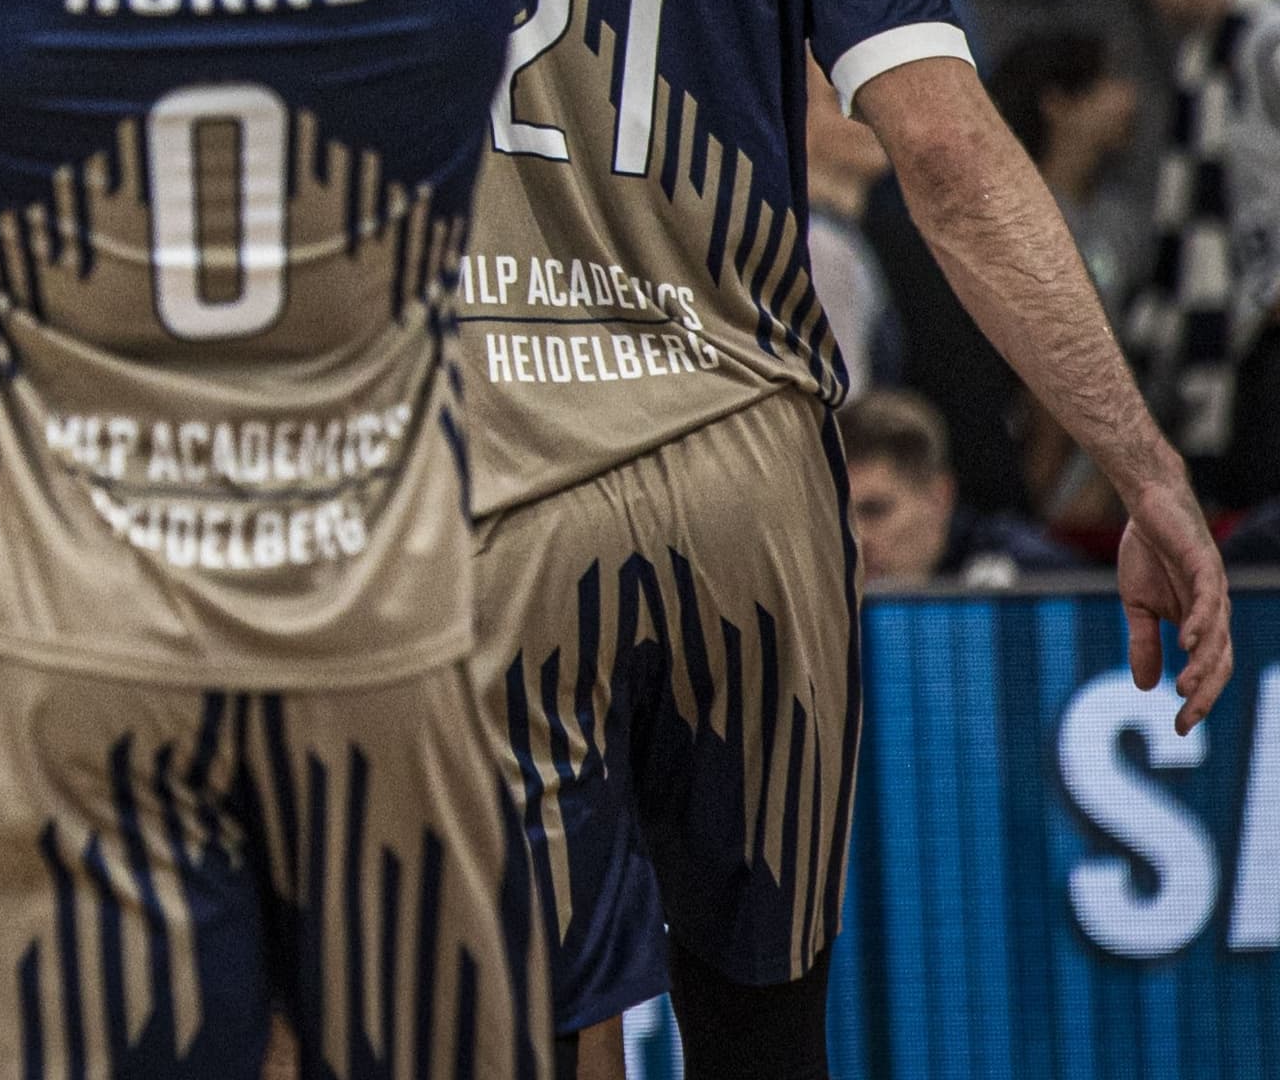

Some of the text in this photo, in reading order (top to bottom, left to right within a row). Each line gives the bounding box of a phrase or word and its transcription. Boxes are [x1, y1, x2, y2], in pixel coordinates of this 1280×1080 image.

[147, 84, 289, 341] 0
[486, 332, 720, 383] HEIDELBERG
[1057, 668, 1280, 958] S
